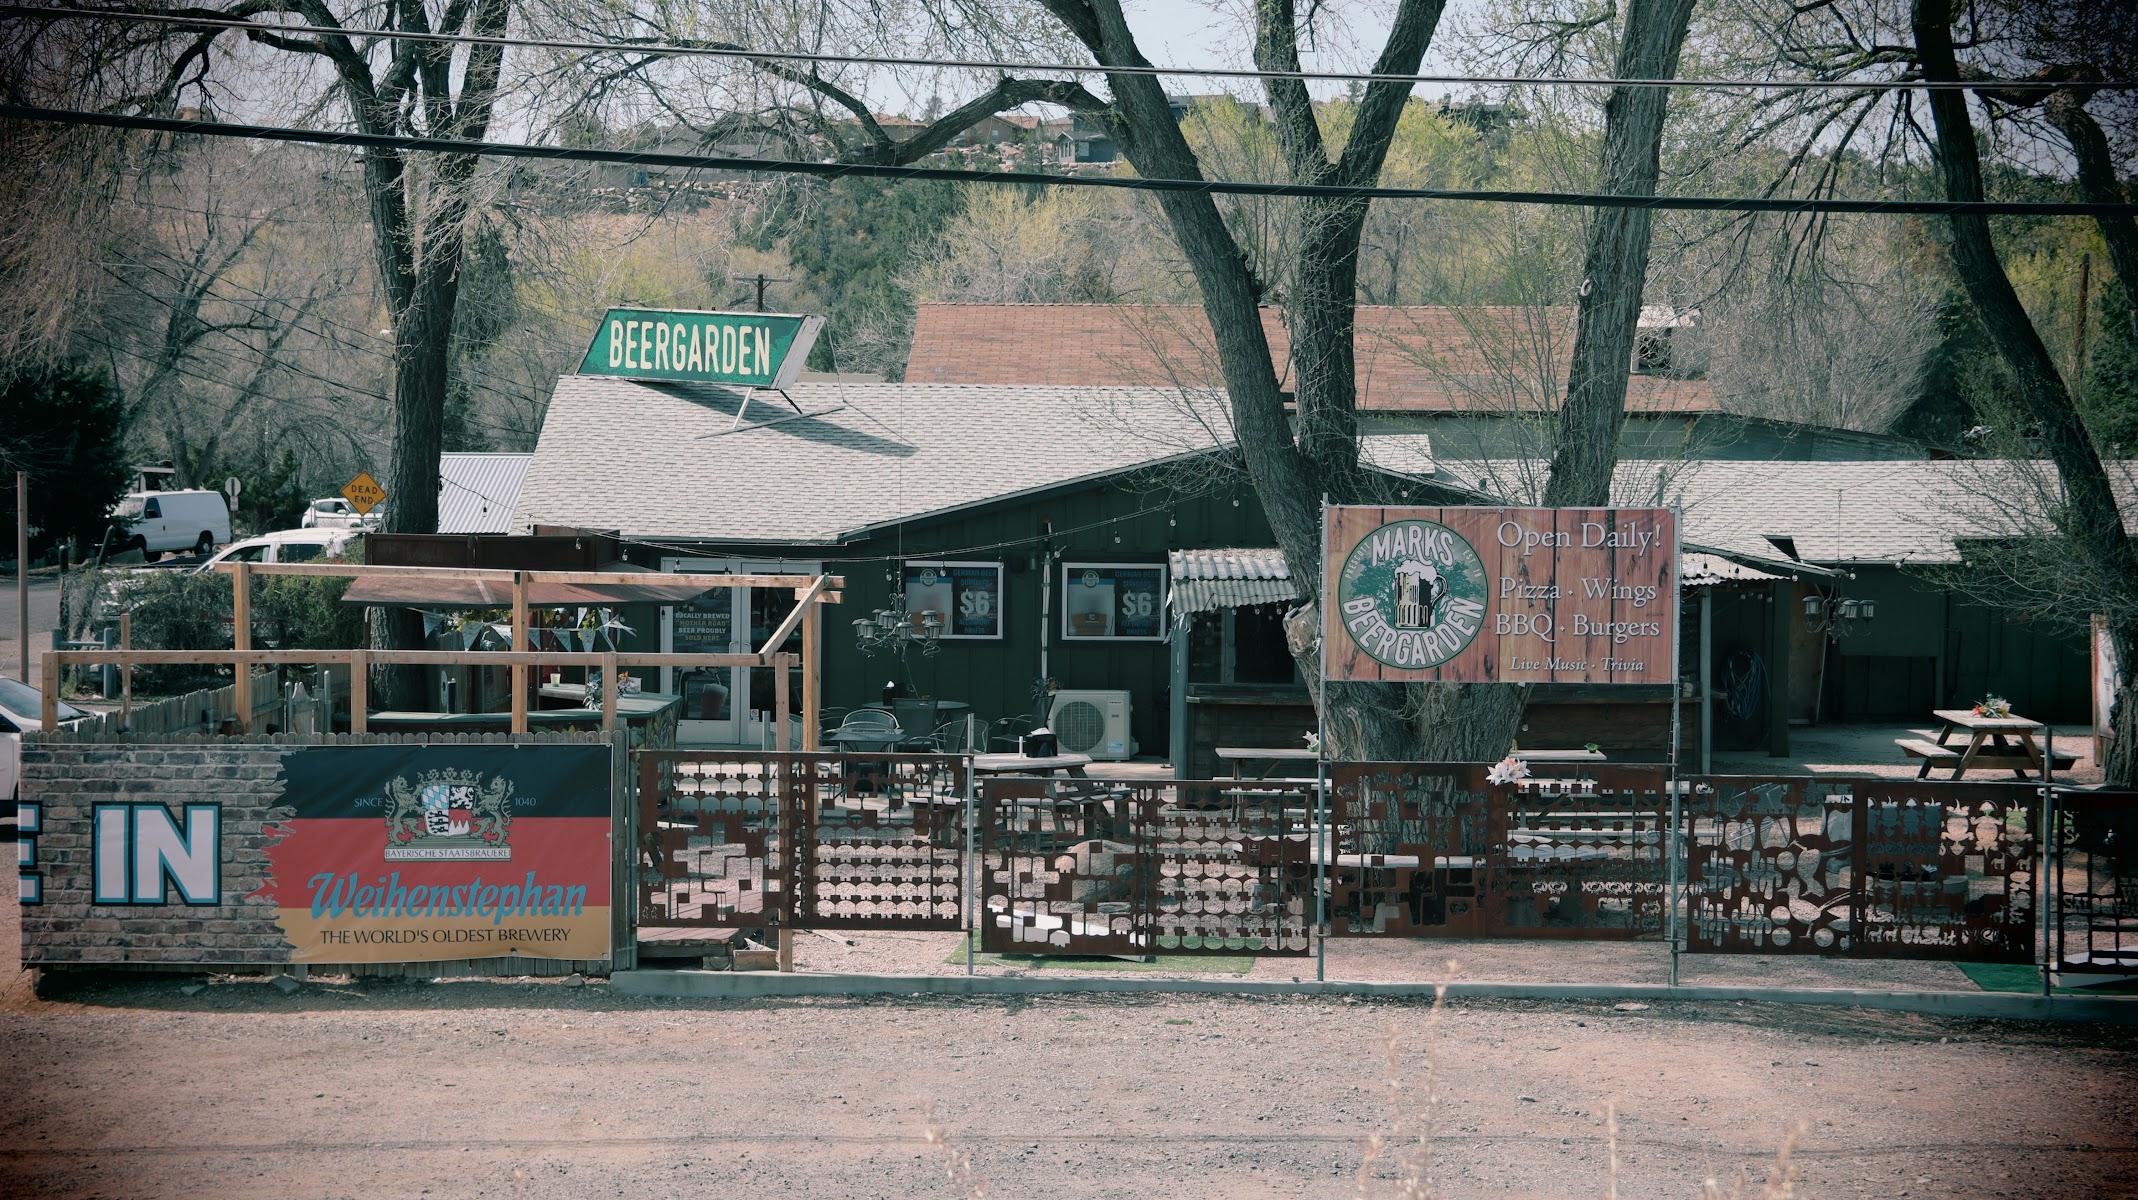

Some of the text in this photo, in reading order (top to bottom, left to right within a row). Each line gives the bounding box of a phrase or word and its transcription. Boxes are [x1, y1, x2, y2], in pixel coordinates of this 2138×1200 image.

[609, 320, 770, 376] BEERGARDEN
[351, 485, 378, 495] DEAD
[354, 495, 374, 505] END
[1371, 525, 1455, 567] MARK'S
[1497, 521, 1662, 557] Open Daily!
[1345, 542, 1371, 579] PRESCOTT
[1462, 549, 1477, 564] EST
[959, 588, 990, 617] $6
[1121, 590, 1152, 618] $6
[1499, 577, 1657, 608] Pizza Wings
[1343, 597, 1484, 666] BEERGARDEN
[1495, 613, 1660, 644] BBQ Burgers
[1510, 656, 1645, 672] Live Music Trivia
[354, 797, 537, 808] SINCE 1040
[92, 801, 223, 907] IN
[385, 849, 511, 858] BAYERISCHE STAATSBRAUEREI
[306, 870, 587, 926] Weihenstephan
[320, 928, 572, 944] THE WORLD'S OLDEST BREWERY
